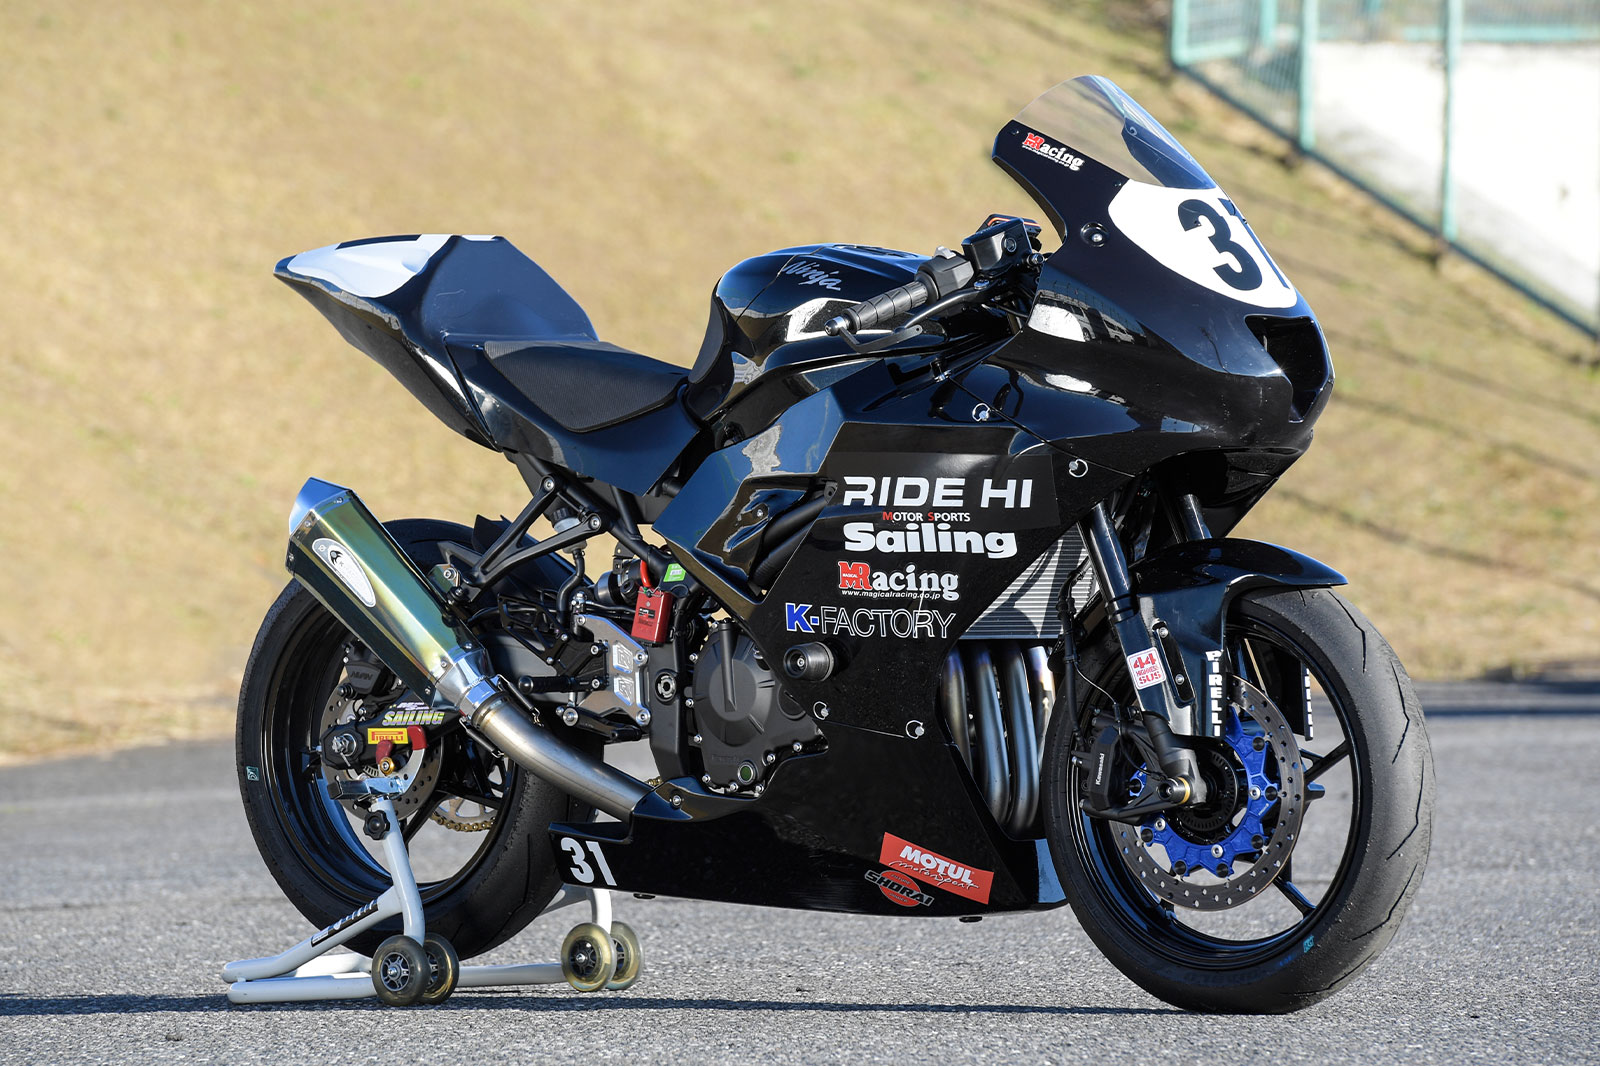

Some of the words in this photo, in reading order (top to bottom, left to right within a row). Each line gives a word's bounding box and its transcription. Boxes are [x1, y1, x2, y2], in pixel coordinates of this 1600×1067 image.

[781, 260, 842, 291] Ninja
[843, 476, 966, 507] RIDE
[980, 478, 1033, 509] HI
[882, 511, 923, 522] MOTOR
[927, 511, 971, 522] SPORTS
[843, 521, 1018, 559] Sailing
[841, 589, 941, 600] www.magicalracing.co.jp
[785, 602, 956, 639] K-FACTORY
[1133, 653, 1157, 669] 44
[1138, 671, 1161, 685] SUS
[1205, 650, 1224, 737] PIRELLI
[381, 710, 445, 727] SAILING
[371, 731, 404, 741] PIRELLI
[560, 837, 618, 886] 31
[900, 845, 974, 884] MOTUL
[864, 869, 935, 907] SHORAI
